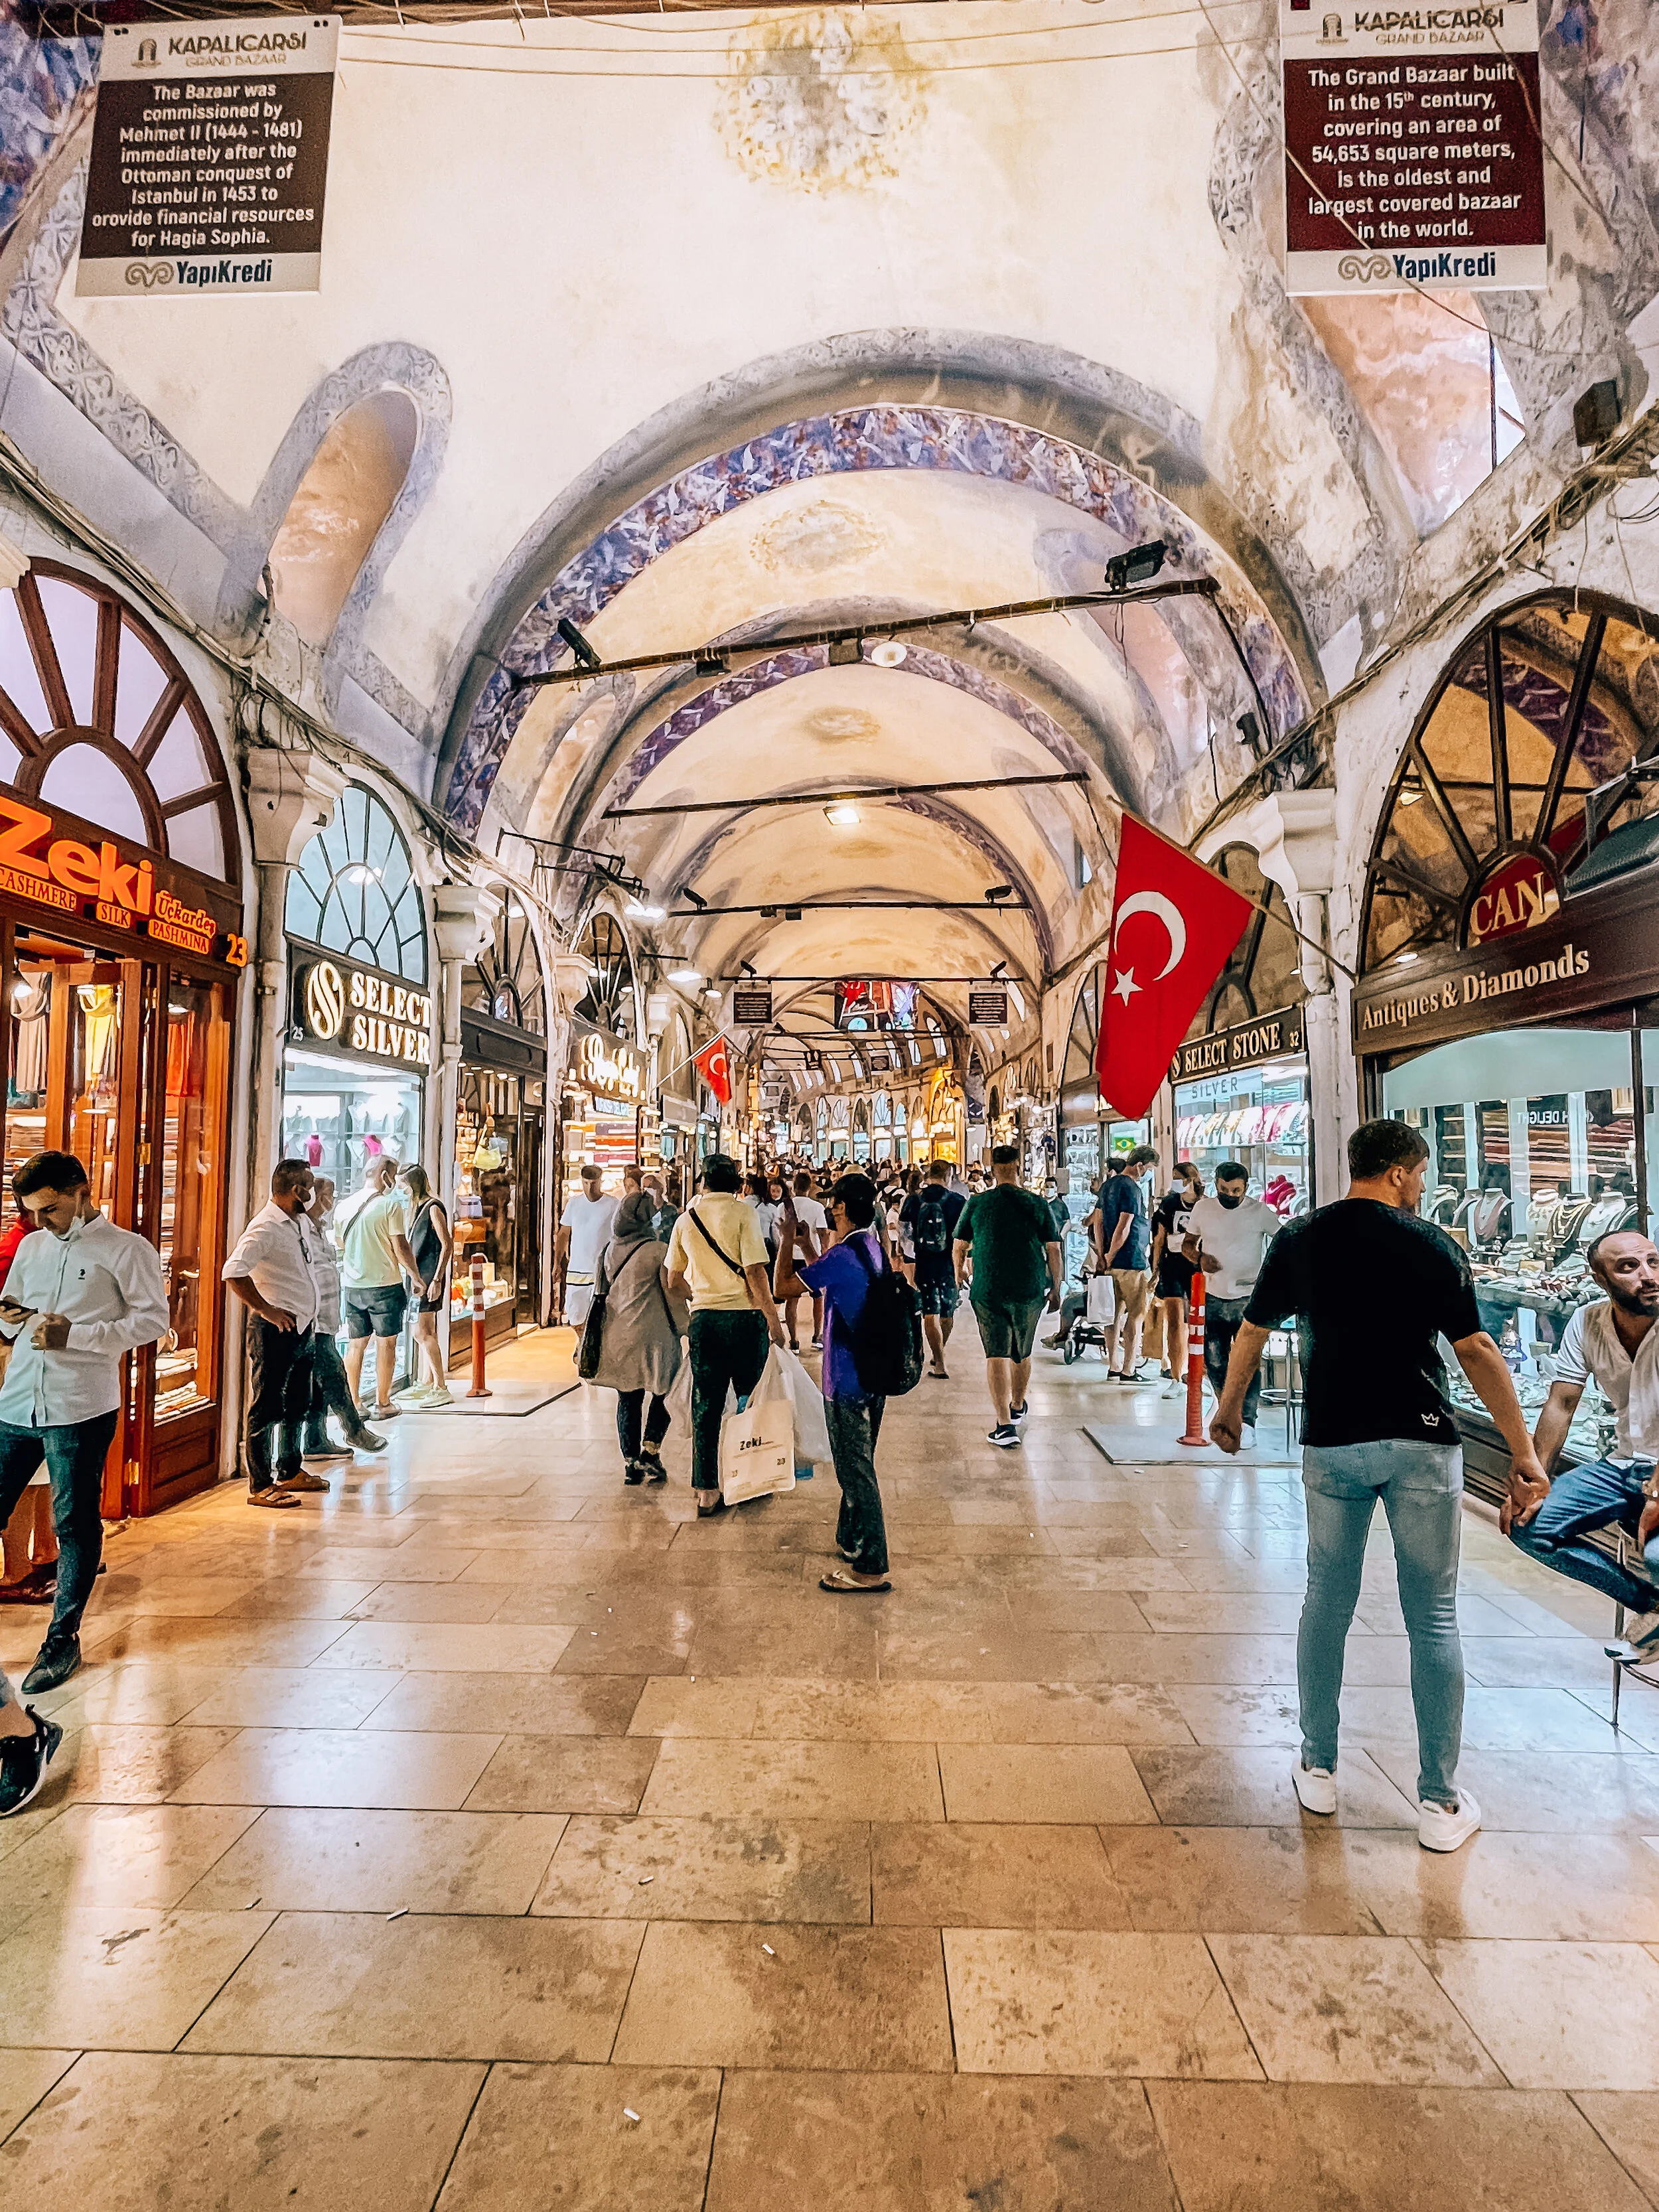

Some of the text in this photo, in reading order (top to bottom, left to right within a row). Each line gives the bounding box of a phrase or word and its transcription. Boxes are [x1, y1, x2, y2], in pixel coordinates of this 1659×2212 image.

[1376, 31, 1484, 45] GRAND BAZAAR
[236, 54, 287, 66] BAZAAR
[1309, 64, 1514, 86] The Grand Bazaar built
[154, 84, 276, 100] The Bazaar was
[1329, 94, 1345, 111] in
[1350, 94, 1380, 110] the
[1420, 92, 1496, 110] century,
[143, 102, 282, 121] commissioned by
[120, 127, 185, 143] Mehmet
[191, 125, 199, 140] II
[265, 119, 302, 139] 1481)
[1324, 114, 1502, 138] covering an area of
[121, 144, 297, 163] immediately after the
[1313, 143, 1515, 165] 54,653 square meters,
[121, 163, 293, 184] Ottoman conquest of
[1359, 170, 1388, 186] the
[1394, 169, 1451, 186] oldest
[1457, 166, 1490, 184] and
[132, 186, 278, 204] Istanbul in 1453 to
[1309, 192, 1521, 218] largest covered bazaar
[157, 208, 226, 224] financial
[232, 207, 314, 222] resources
[132, 229, 270, 248] for Hagia Sophia.
[1358, 220, 1473, 239] in the world.
[0, 796, 153, 915] Zeki
[1471, 872, 1545, 936] CAN
[102, 904, 129, 926] SILK
[153, 921, 207, 952] PASHMINA
[226, 933, 248, 968] 23
[1362, 944, 1590, 1030] Antiques & Diamonds
[350, 971, 432, 1028] SELECT
[292, 1026, 304, 1041] 25
[352, 1013, 430, 1065] SILVER
[1185, 1039, 1227, 1072] SELECT
[1233, 1022, 1280, 1060] STONE
[1191, 1076, 1238, 1099] SILVER
